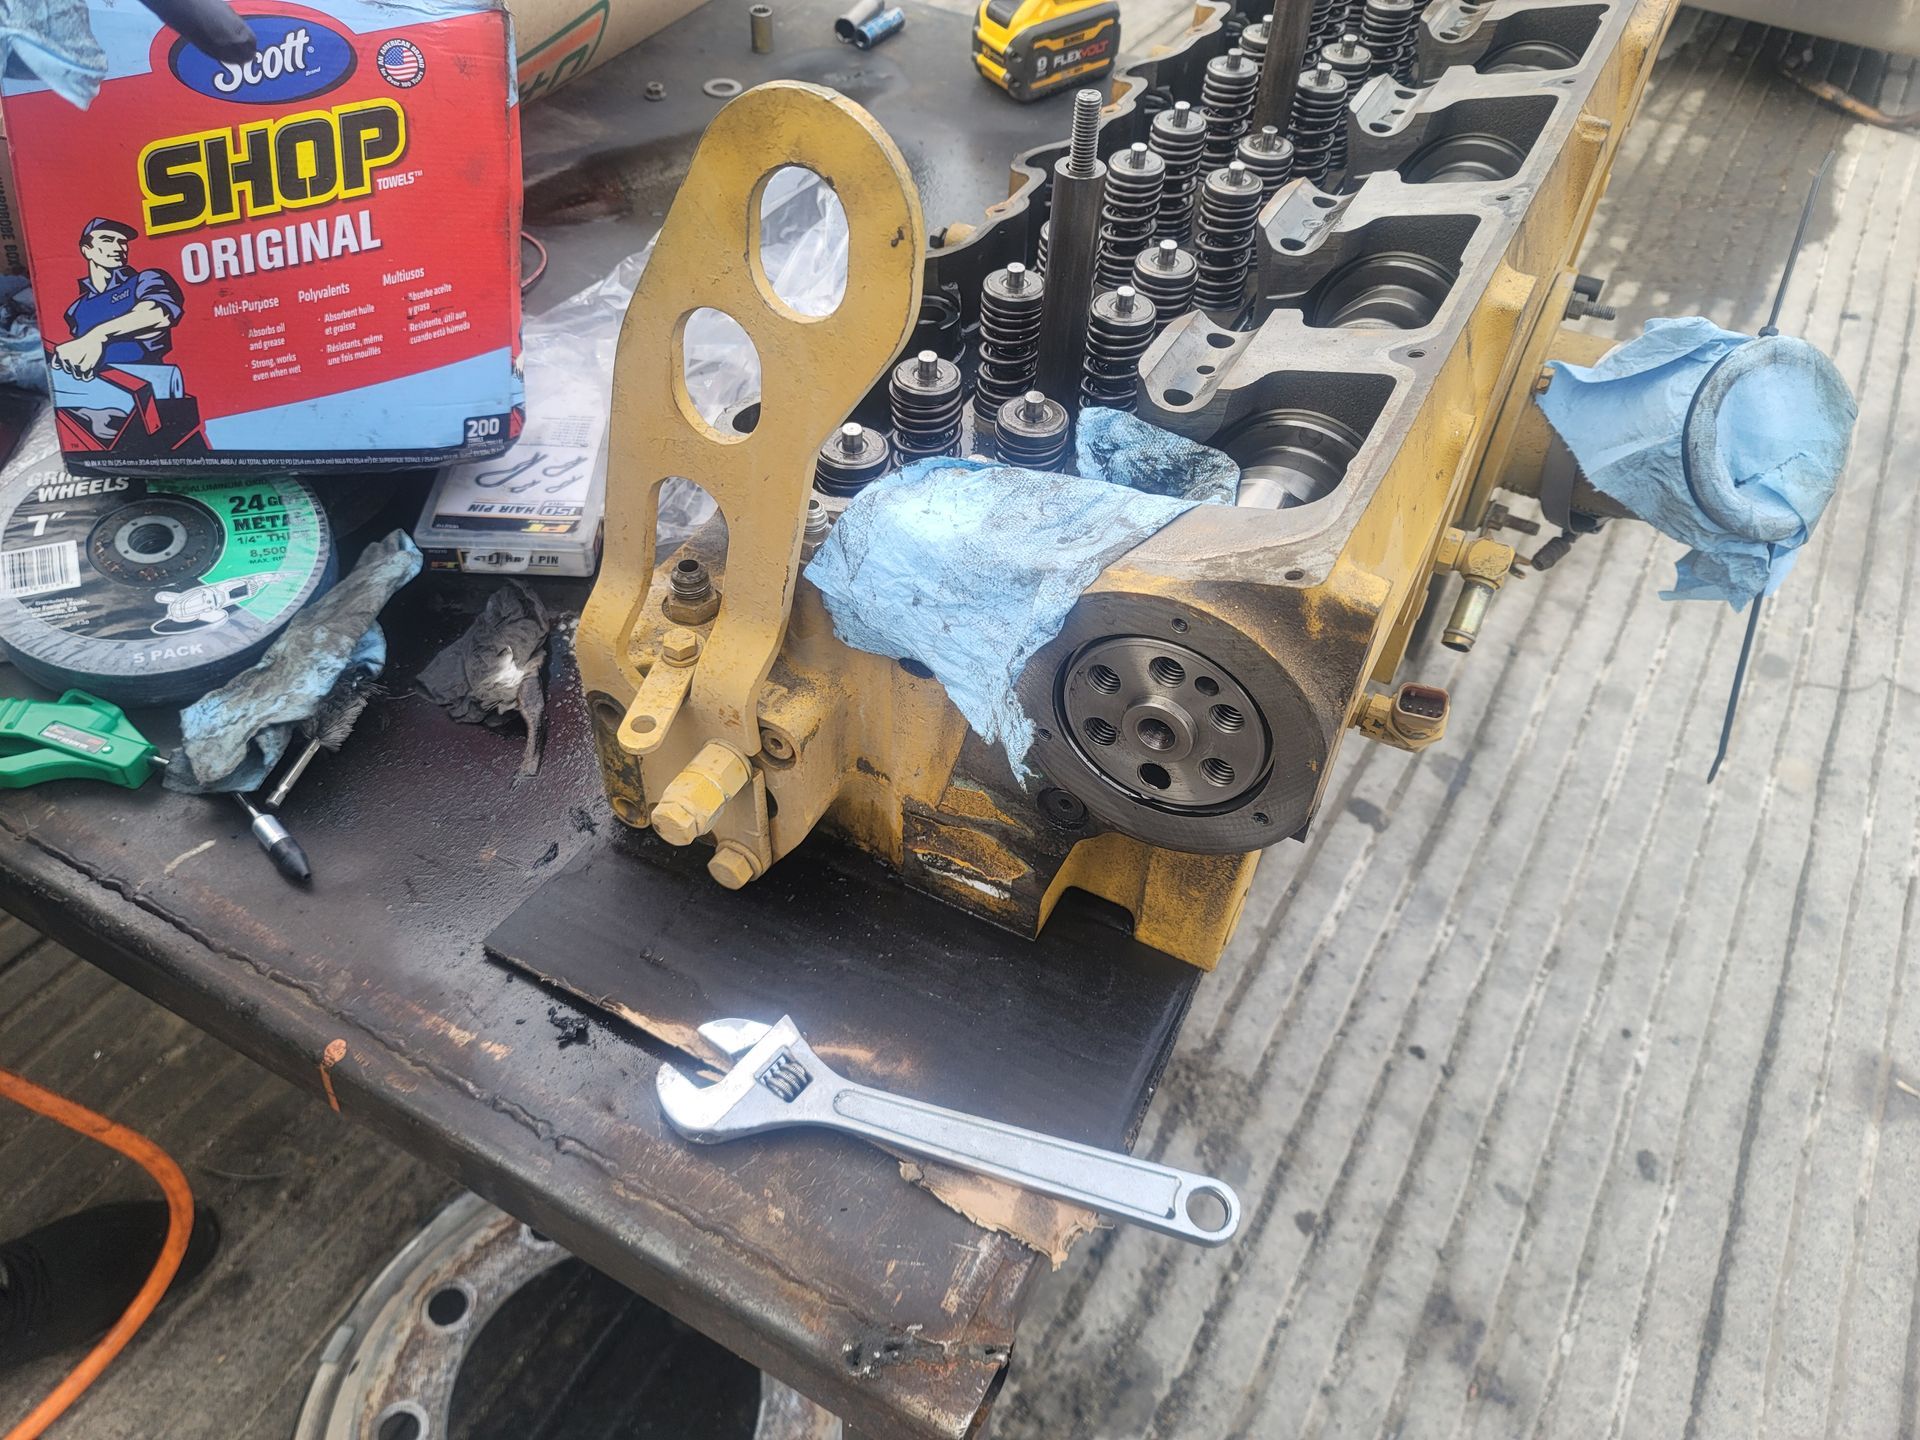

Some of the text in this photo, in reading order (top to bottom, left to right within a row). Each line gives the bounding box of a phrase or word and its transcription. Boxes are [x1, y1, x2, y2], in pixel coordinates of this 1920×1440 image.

[380, 39, 411, 55] AMERICAN
[410, 45, 425, 68] BRAND
[1053, 39, 1109, 68] FLEXVOLT
[138, 98, 405, 234] SHOP
[181, 209, 382, 284] ORIGINAL
[382, 267, 425, 286] Multiusos
[111, 289, 130, 303] Scott
[298, 282, 350, 303] Polyvalents
[408, 287, 433, 301] Absorbe
[213, 297, 280, 318] Multi-Purpose
[324, 308, 358, 323] Absorbent
[248, 323, 286, 338] Absorbs oil
[333, 321, 356, 337] graisse
[249, 337, 285, 351] and grease
[251, 353, 297, 370] Strong, works
[252, 364, 302, 381] even when wet
[466, 417, 500, 438] 200
[37, 477, 130, 502] WHEELS
[229, 494, 265, 514] 24
[467, 504, 495, 512] PIN
[499, 505, 536, 514] HAIR
[538, 556, 559, 564] PIN
[133, 644, 204, 664] 5 PACK
